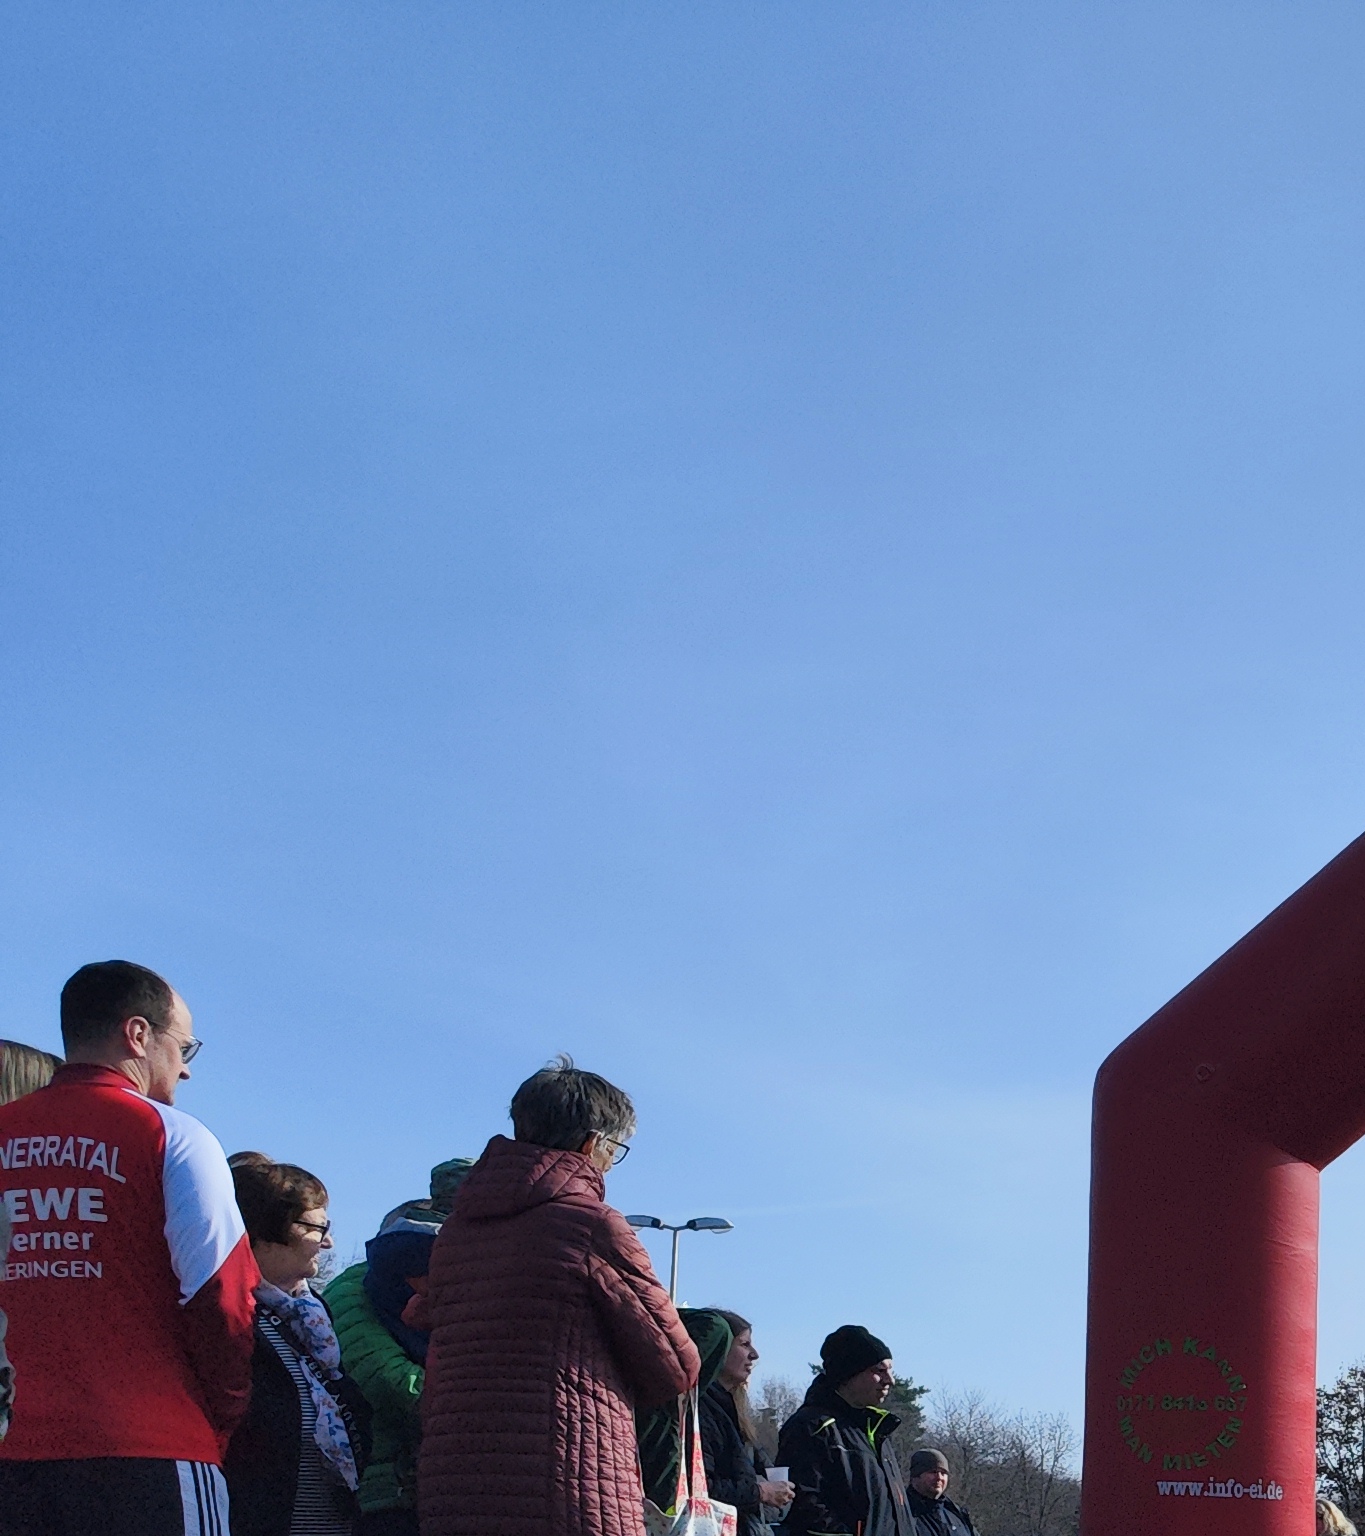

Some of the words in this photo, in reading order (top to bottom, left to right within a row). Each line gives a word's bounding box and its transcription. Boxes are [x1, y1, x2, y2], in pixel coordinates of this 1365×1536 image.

[3, 1187, 108, 1223] EWE
[12, 1230, 95, 1252] erner
[5, 1260, 103, 1281] ERINGEN
[1119, 1337, 1172, 1390] MICH
[1182, 1336, 1247, 1393] KANN
[1119, 1415, 1152, 1464] MAN
[1162, 1416, 1244, 1472] MIETEN
[1156, 1476, 1284, 1500] www.info-ei.de
